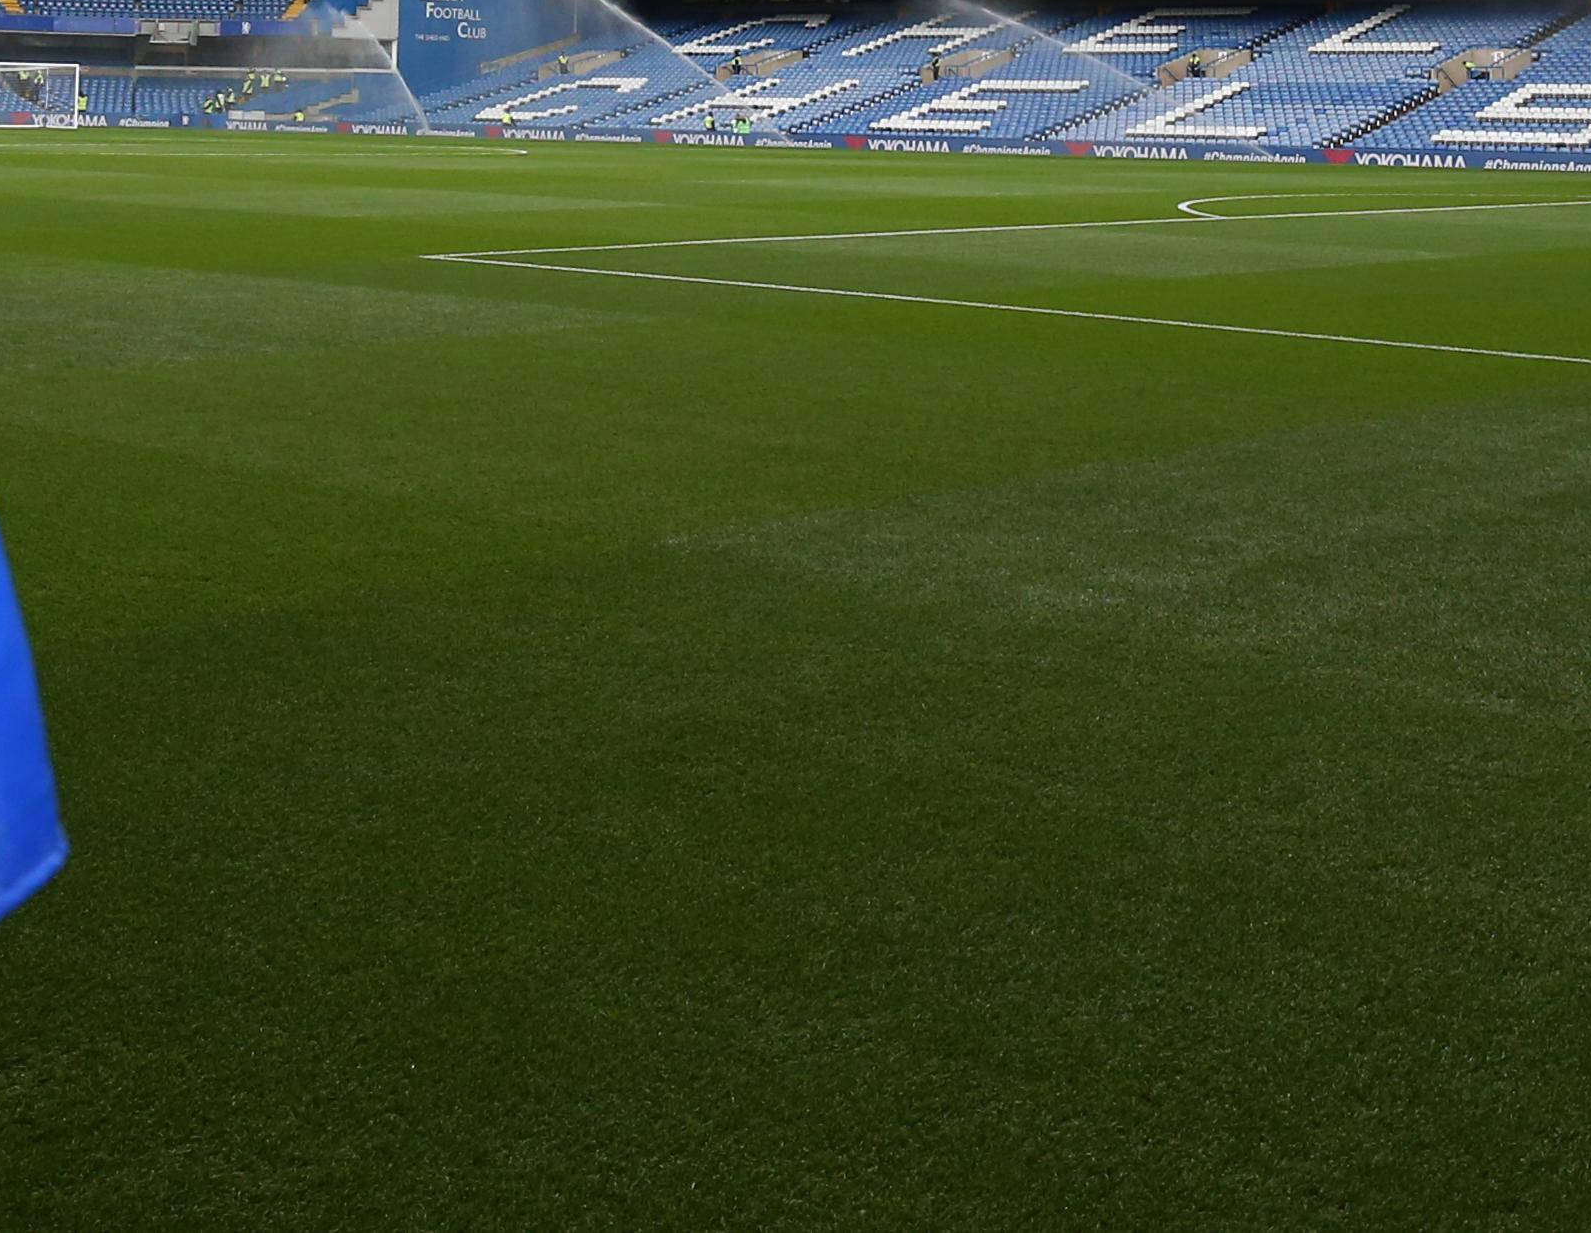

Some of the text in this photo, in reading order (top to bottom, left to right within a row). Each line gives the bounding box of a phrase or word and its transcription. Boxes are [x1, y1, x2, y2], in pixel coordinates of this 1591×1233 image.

[426, 2, 481, 21] FOOTBALL
[457, 22, 487, 39] CLUB
[32, 114, 107, 128] YOKOHAMA
[672, 133, 745, 146] YOKOHAMA
[867, 139, 950, 153] YOKOHAMA
[1092, 144, 1189, 160] YOKOHAMA
[1354, 151, 1467, 169] YOKOHAMA
